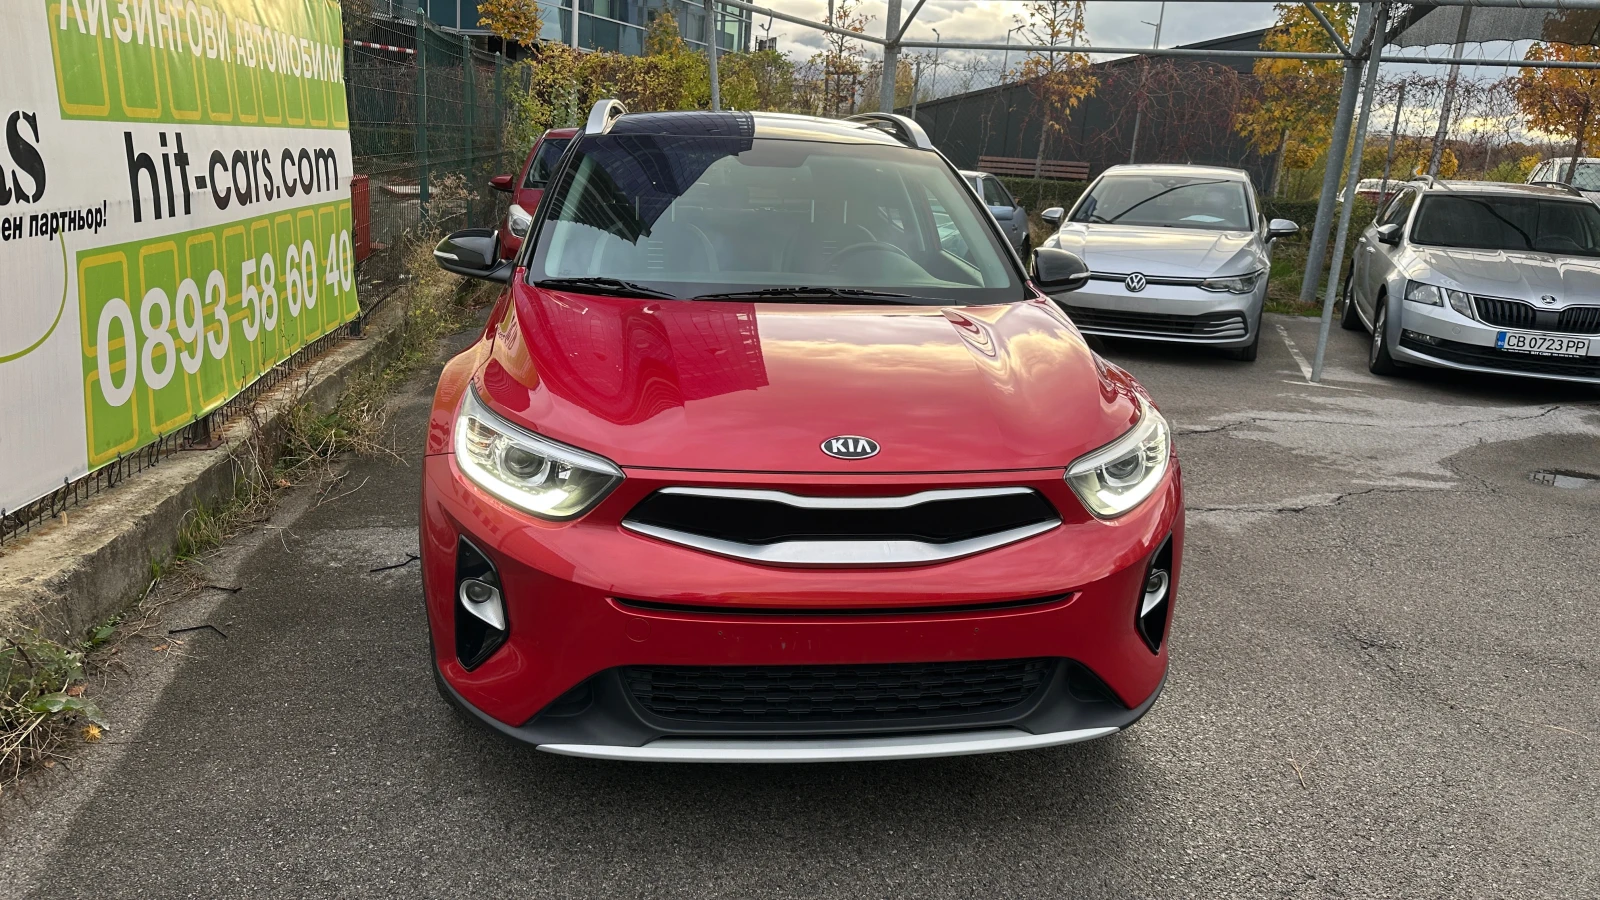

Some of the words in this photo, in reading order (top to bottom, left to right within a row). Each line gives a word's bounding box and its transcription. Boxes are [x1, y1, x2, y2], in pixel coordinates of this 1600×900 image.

[235, 17, 342, 84] АВТОМОБИЛИ
[123, 131, 339, 223] hit-cars.com
[28, 199, 107, 241] партньор!
[97, 269, 230, 407] 0893
[241, 252, 279, 342] 58
[285, 240, 318, 317] 60
[325, 229, 352, 298] 40
[1507, 335, 1526, 348] CB
[1528, 336, 1564, 351] 0723
[1565, 340, 1586, 353] PP
[831, 438, 872, 453] KIA
